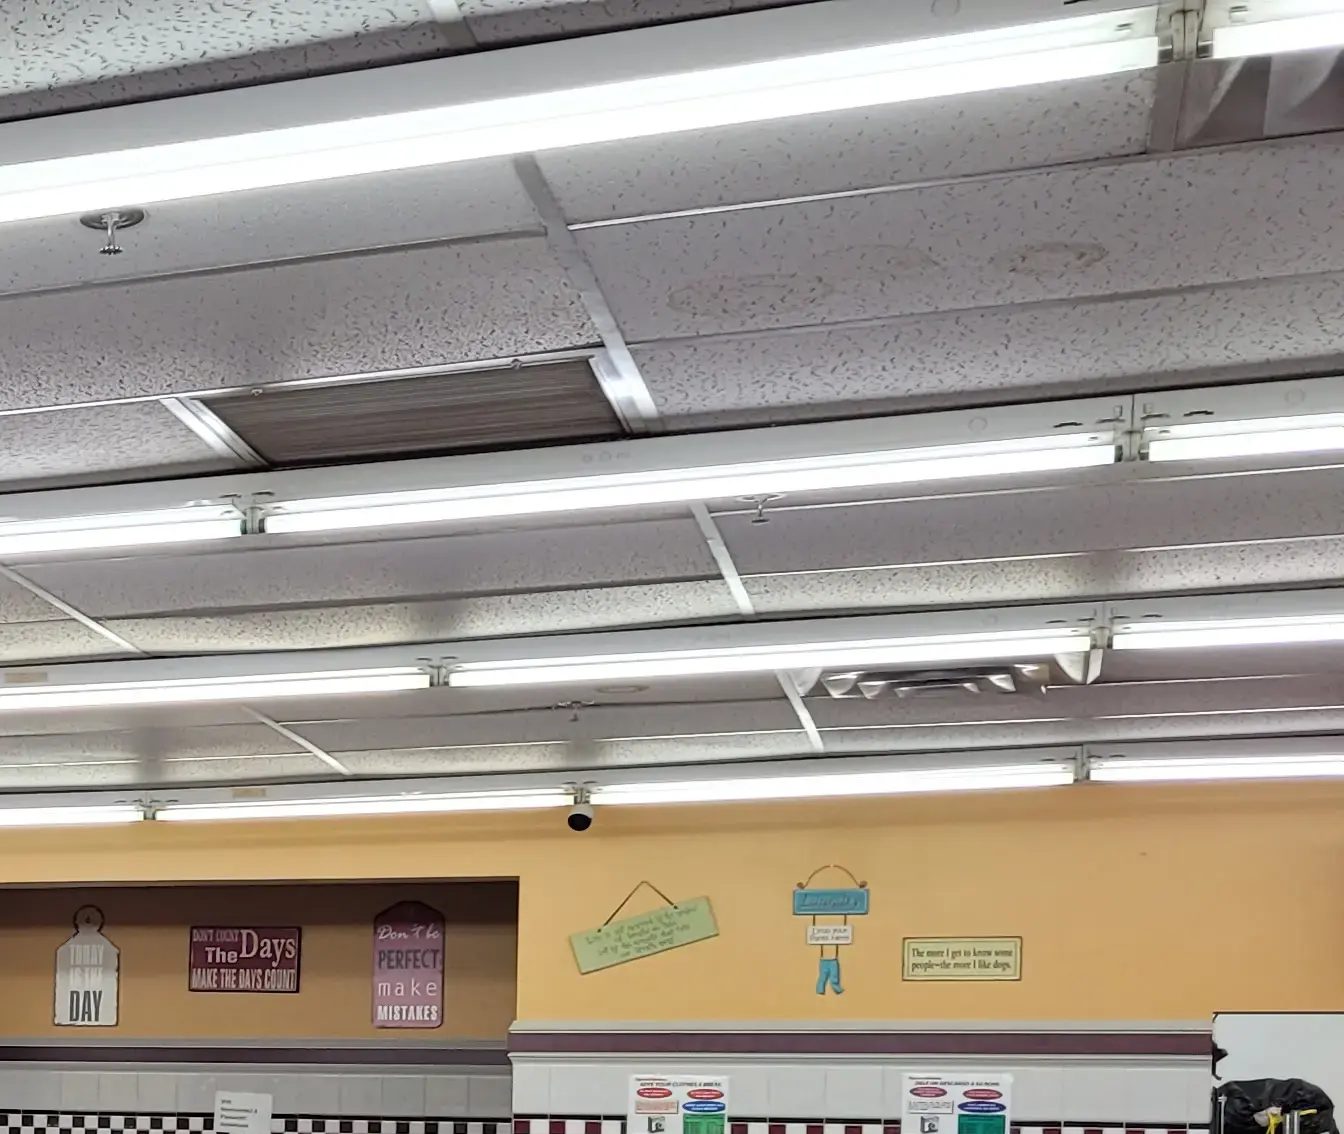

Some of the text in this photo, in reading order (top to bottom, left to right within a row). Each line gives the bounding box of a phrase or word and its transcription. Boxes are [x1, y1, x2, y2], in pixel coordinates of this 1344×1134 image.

[377, 923, 440, 940] Don't be
[205, 929, 296, 968] The Days
[912, 948, 925, 957] The
[951, 950, 962, 960] get
[973, 948, 992, 957] know
[378, 949, 440, 970] PERFECT
[953, 962, 972, 970] more
[978, 960, 992, 969] like
[993, 960, 1011, 971] dogs.
[192, 968, 296, 991] MAKE THE DAYS COUNT
[378, 978, 437, 996] make
[69, 990, 102, 1022] DAY
[377, 1005, 438, 1020] MISTAKES
